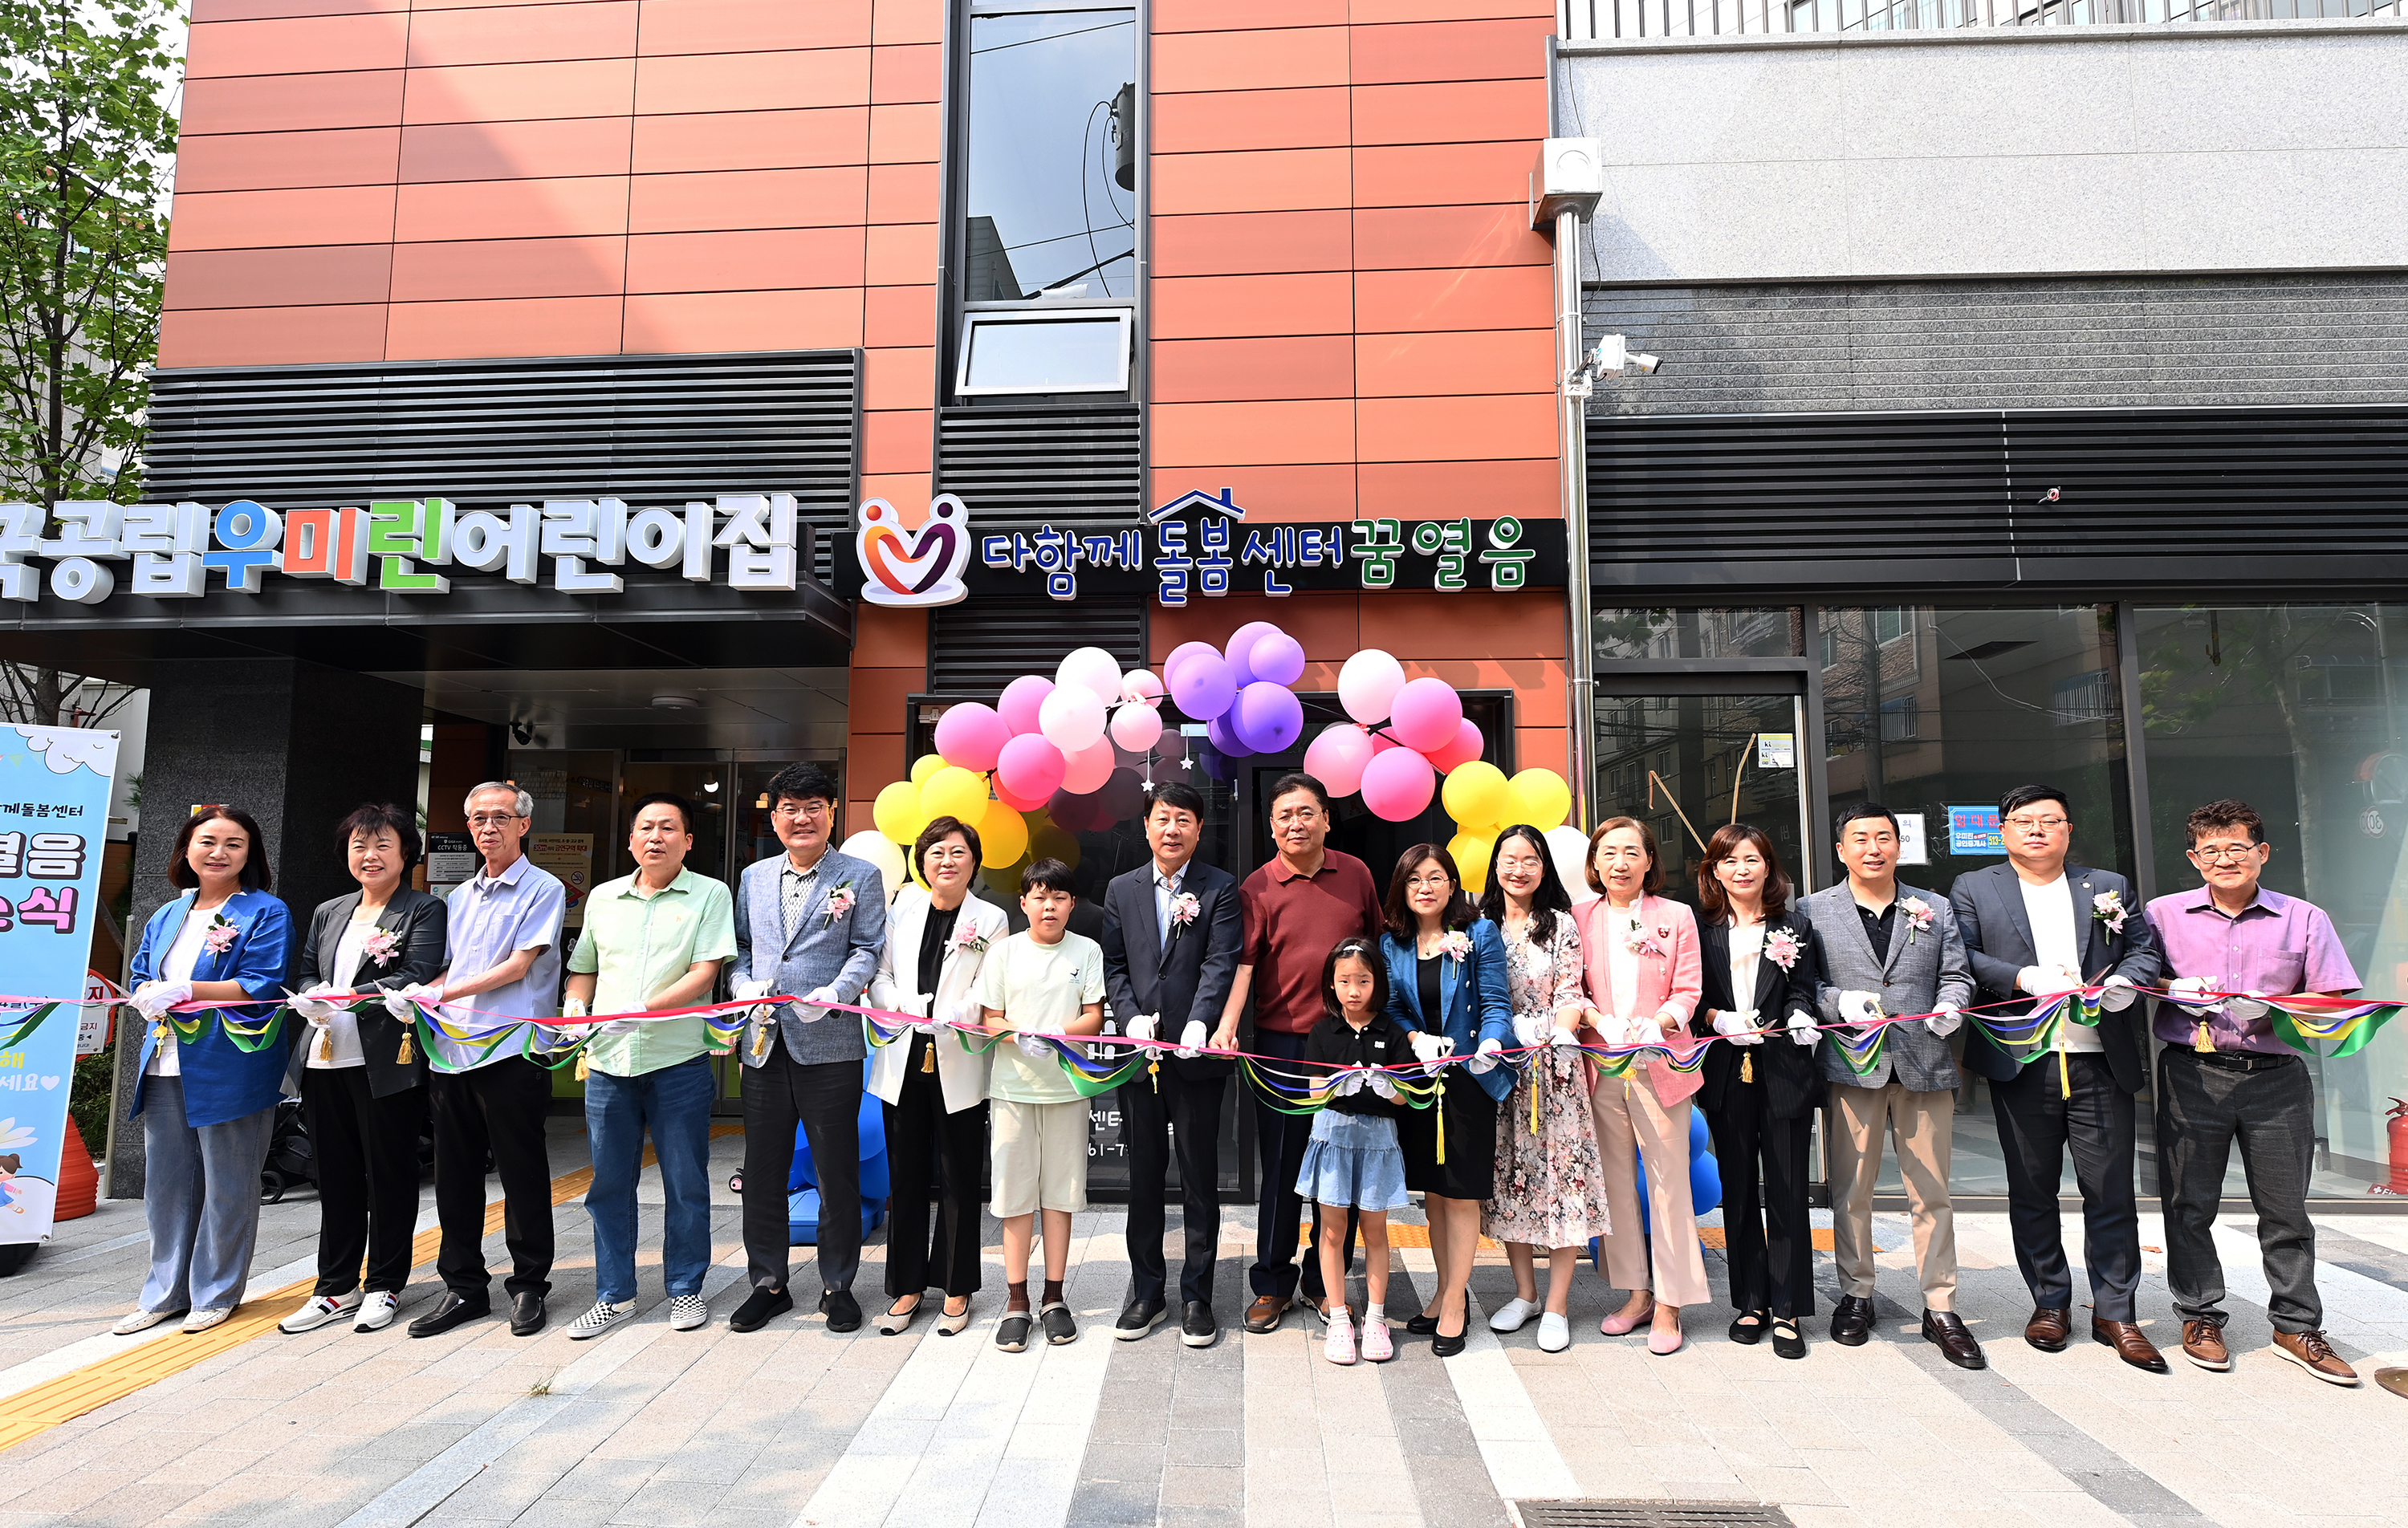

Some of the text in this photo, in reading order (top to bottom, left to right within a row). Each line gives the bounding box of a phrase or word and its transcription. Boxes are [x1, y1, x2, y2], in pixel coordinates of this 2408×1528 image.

[0, 803, 83, 819] 께돌봄센터
[0, 886, 79, 934] 식
[1088, 1143, 1129, 1157] 61-7
